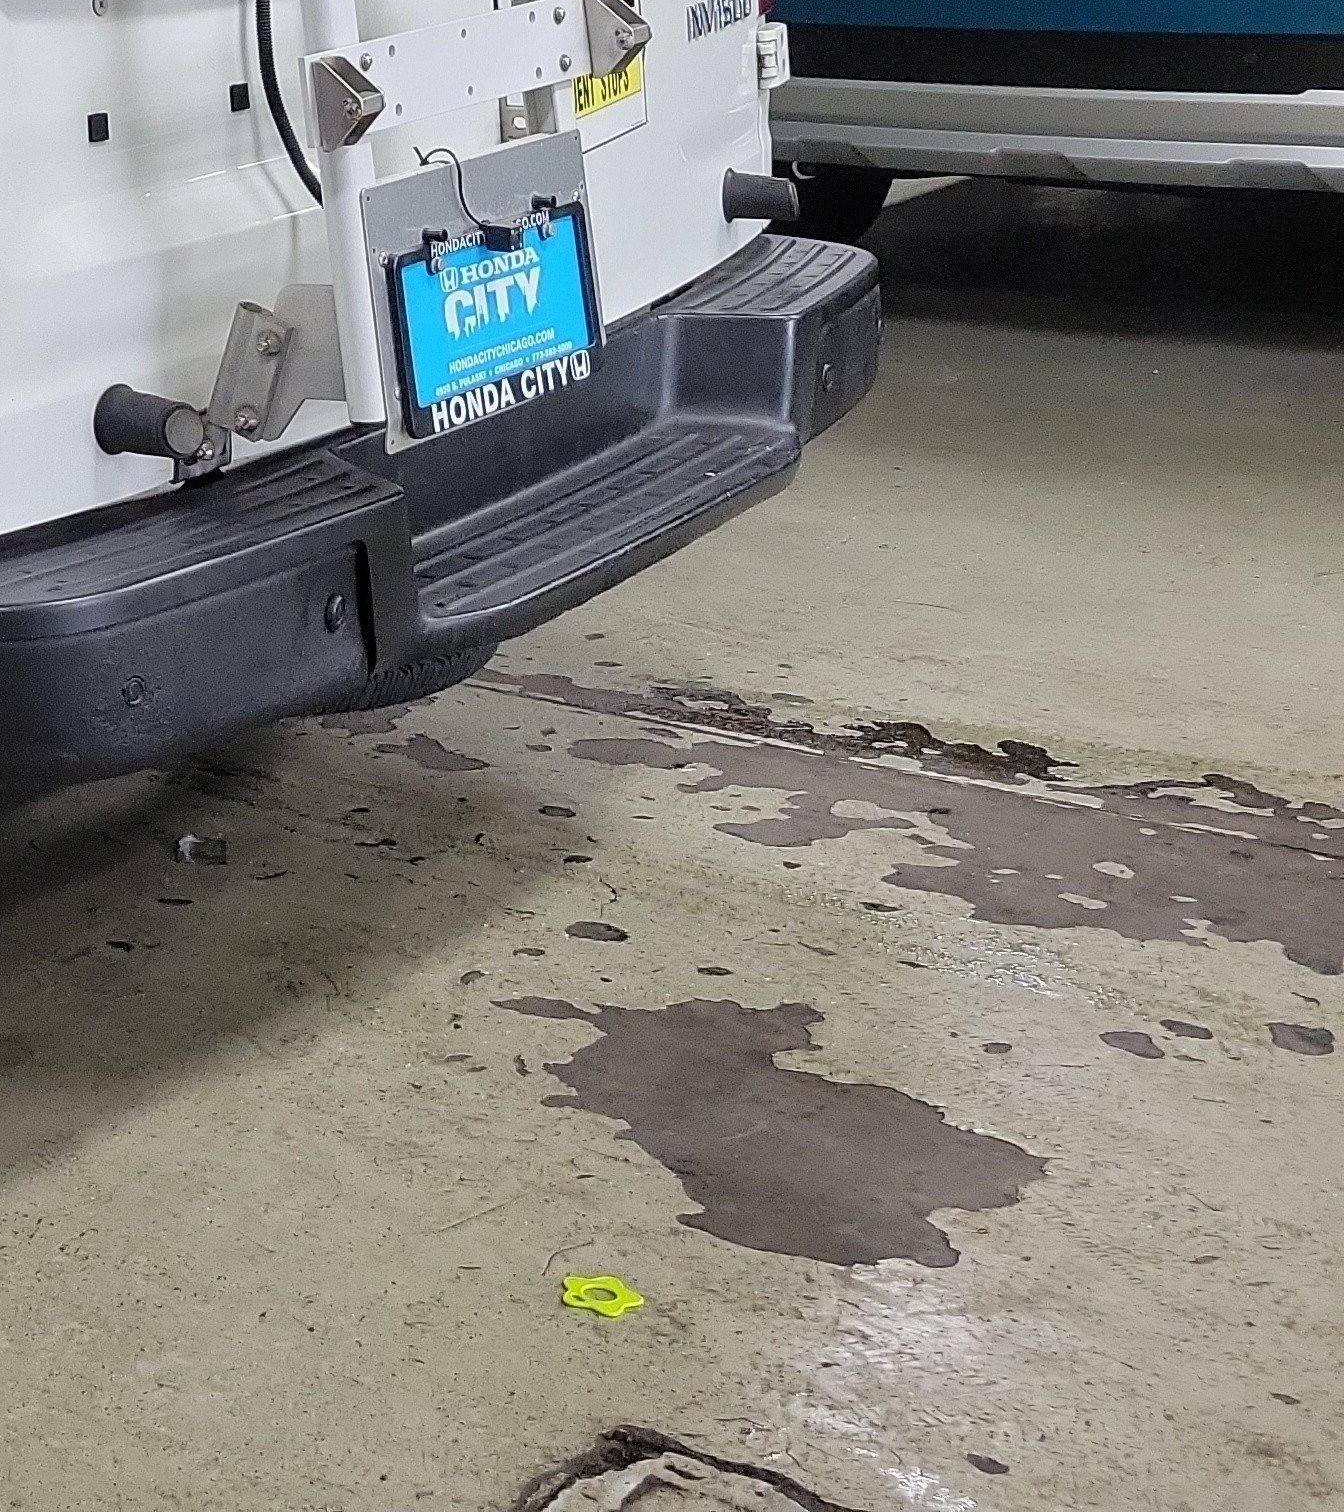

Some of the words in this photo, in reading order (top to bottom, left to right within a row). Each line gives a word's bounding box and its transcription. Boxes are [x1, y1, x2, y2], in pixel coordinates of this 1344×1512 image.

[461, 246, 540, 285] HONDA
[445, 266, 541, 341] CITY
[448, 327, 555, 375] HONDACITYCHICAGO.COM
[431, 379, 516, 432] HONDA
[520, 354, 572, 400] CITY
